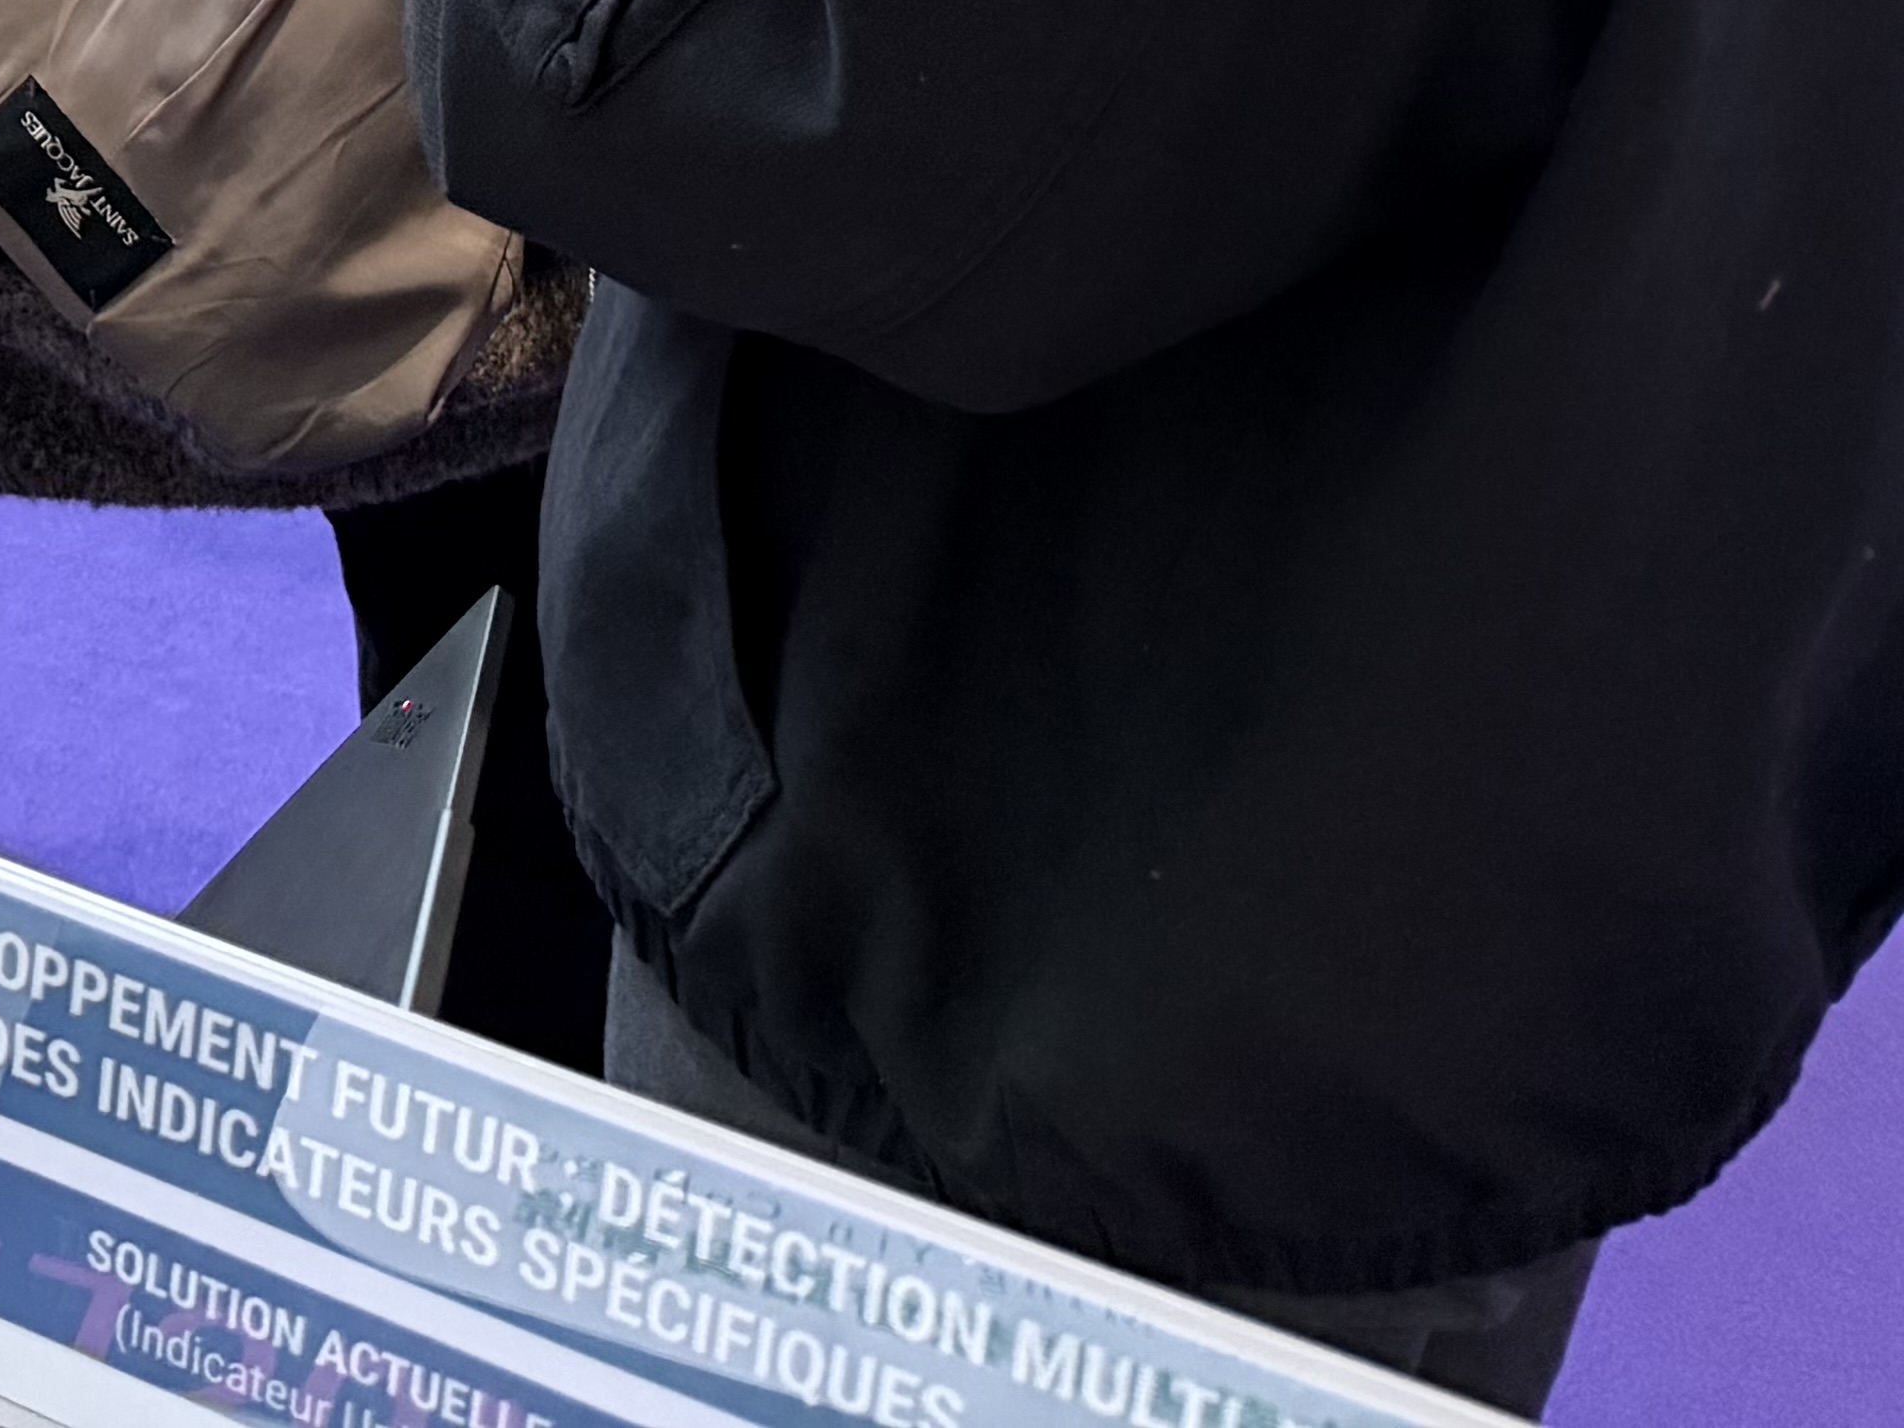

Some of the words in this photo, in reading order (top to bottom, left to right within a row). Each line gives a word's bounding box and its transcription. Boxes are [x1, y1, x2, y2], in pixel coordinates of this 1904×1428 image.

[20, 109, 100, 202] JACQUES
[93, 197, 139, 247] SAINT
[97, 1058, 503, 1268] INDICATEURS
[520, 1227, 966, 1428] SPÉCIFIQUES
[331, 1063, 542, 1194] FUTUR
[598, 1161, 996, 1367] DÉTECTION
[87, 1229, 306, 1355] SOLUTION
[317, 1332, 558, 1428] ACTUELLE
[114, 1303, 331, 1428] (Indicateur
